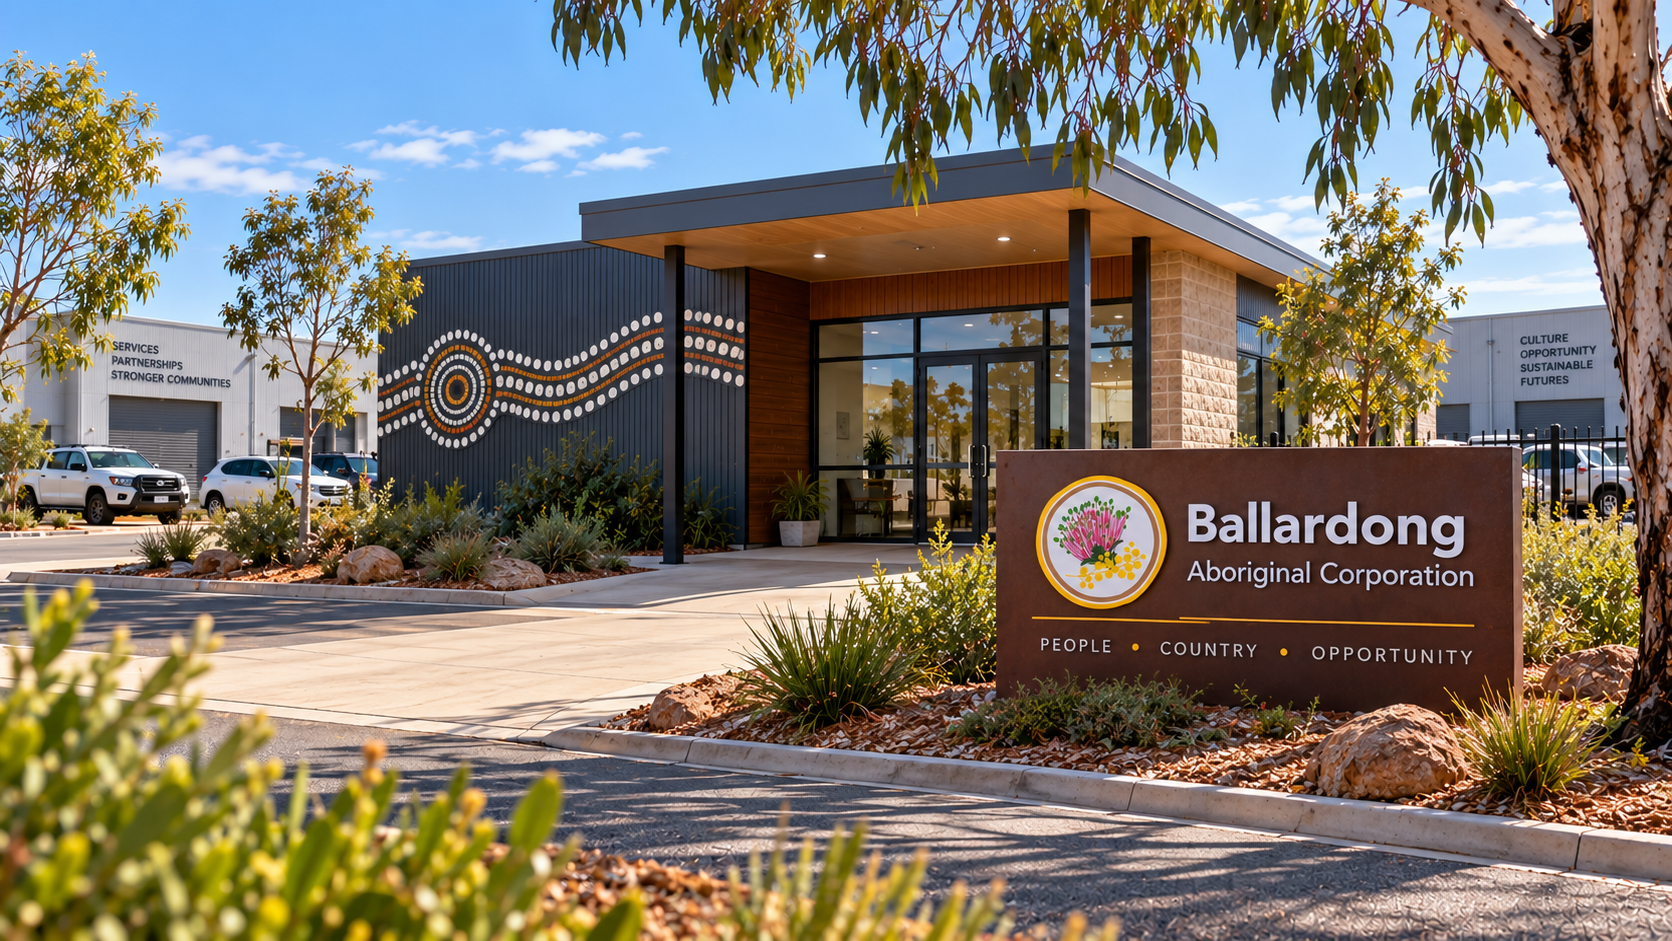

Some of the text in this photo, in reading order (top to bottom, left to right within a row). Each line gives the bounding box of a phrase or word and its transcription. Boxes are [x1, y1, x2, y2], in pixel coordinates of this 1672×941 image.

[1520, 333, 1569, 345] CULTURE
[112, 341, 159, 354] SERVICES
[1520, 345, 1597, 359] OPPORTUNITY
[111, 355, 183, 370] PARTNERSHIPS
[1520, 360, 1593, 373] SUSTAINABLE
[111, 370, 231, 388] STRONGER COMMUNITIES
[1520, 375, 1569, 387] FUTURES
[1187, 501, 1465, 559] Ballardong
[1187, 560, 1474, 591] Aboriginal Corporation
[1040, 637, 1473, 665] PEOPLE COUNTRY OPPORTUNITY
